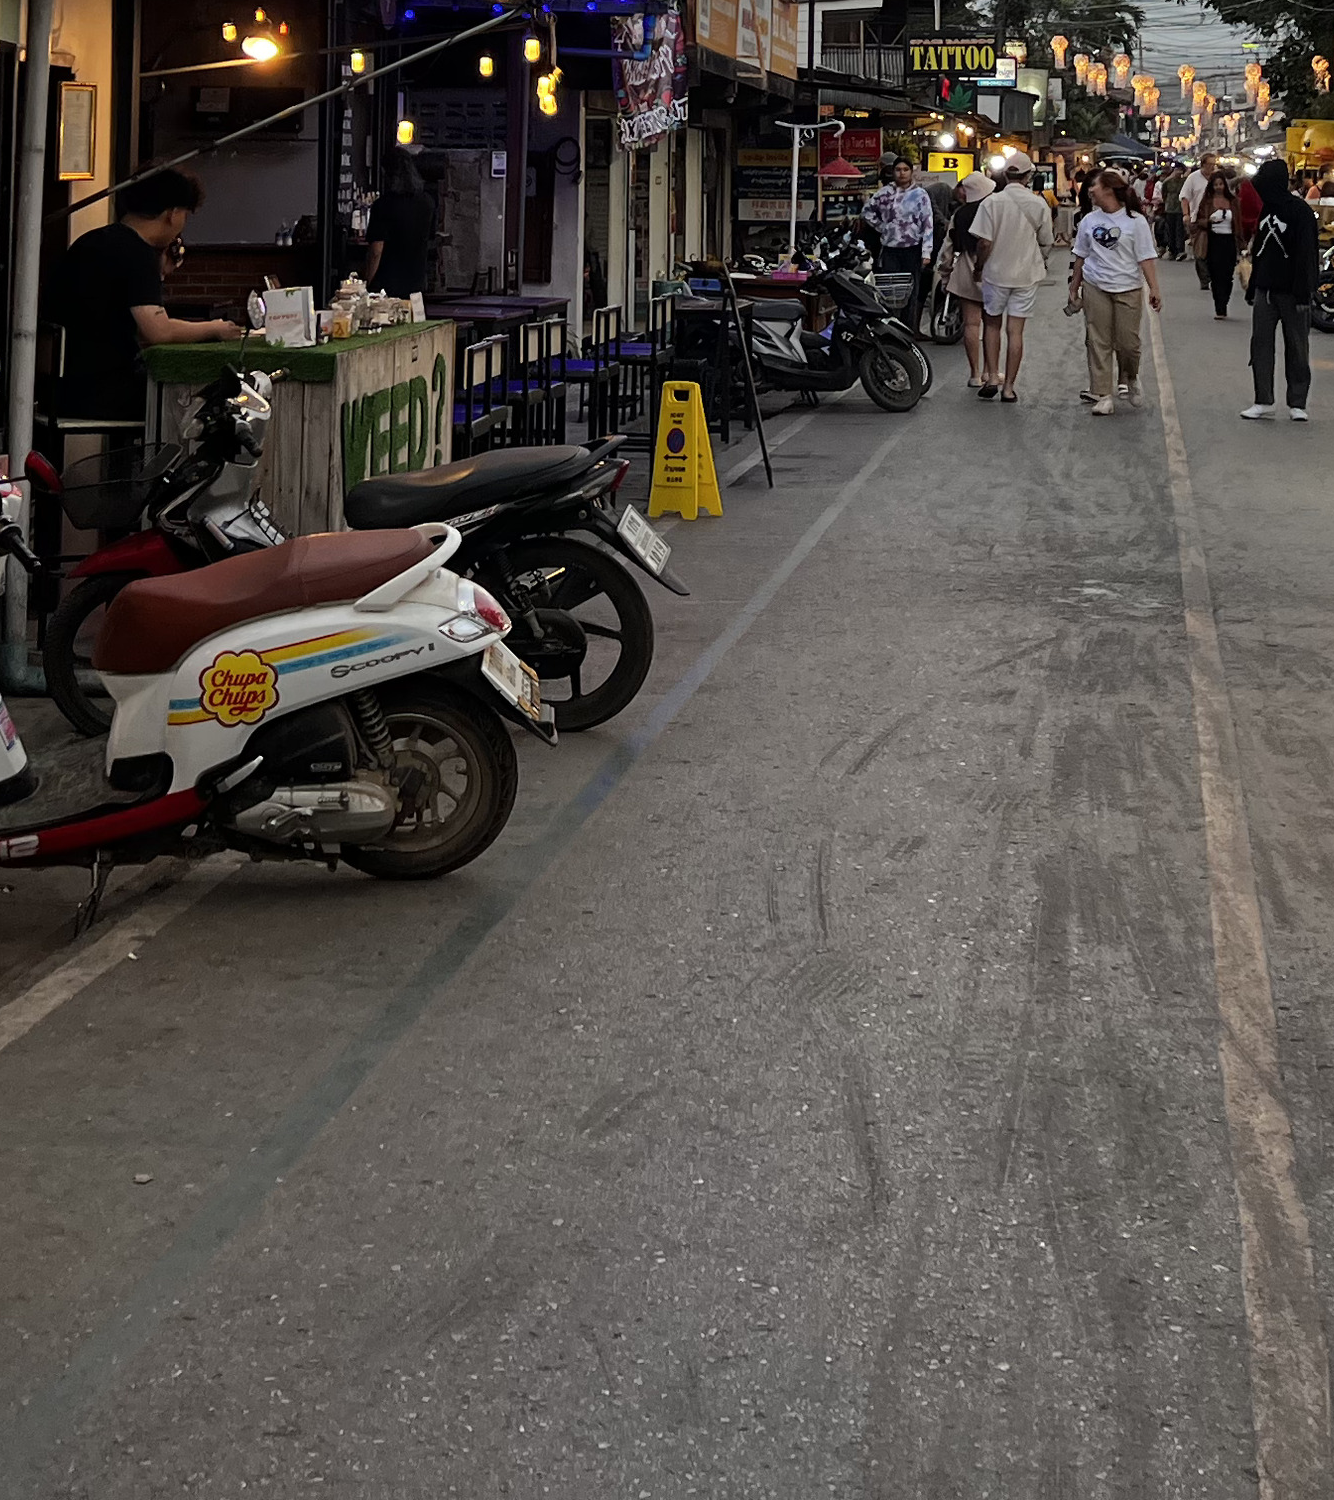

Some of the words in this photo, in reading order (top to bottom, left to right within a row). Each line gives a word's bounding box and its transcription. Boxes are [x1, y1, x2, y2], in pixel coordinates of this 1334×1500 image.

[909, 45, 996, 71] TATTOO
[942, 157, 959, 169] B
[341, 352, 447, 493] WEED?
[210, 669, 269, 690] Chupa
[207, 686, 268, 717] Chups
